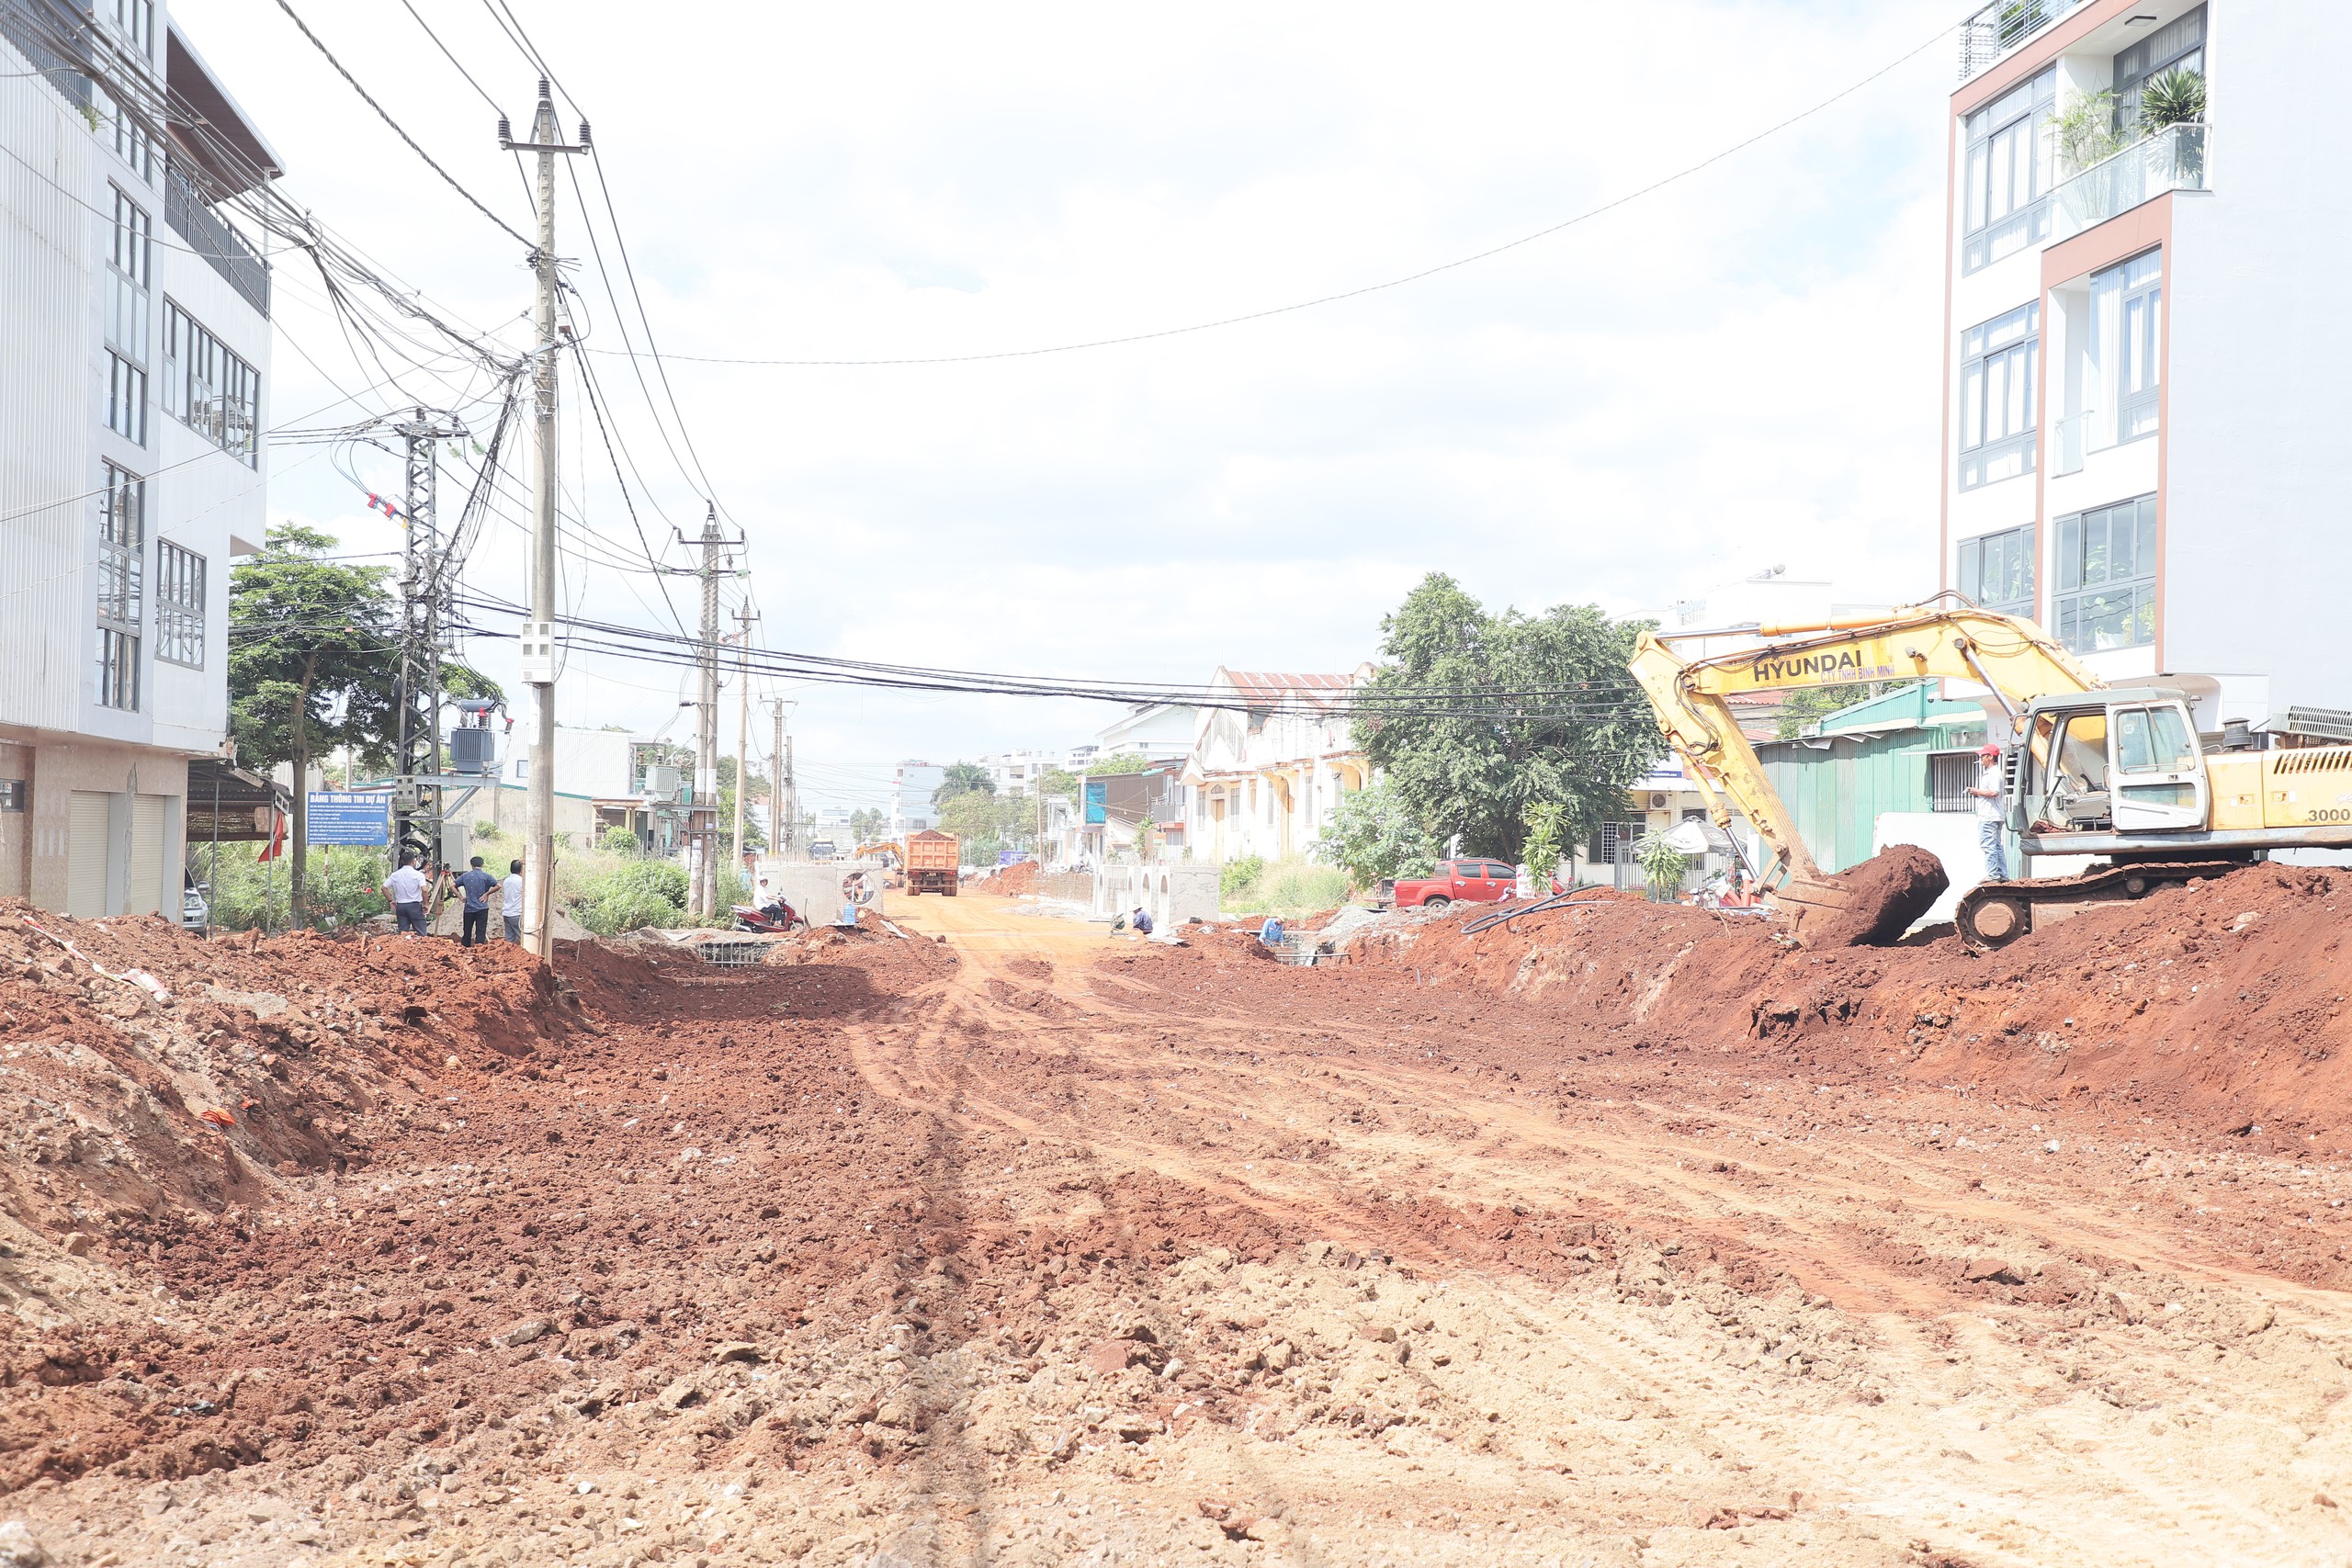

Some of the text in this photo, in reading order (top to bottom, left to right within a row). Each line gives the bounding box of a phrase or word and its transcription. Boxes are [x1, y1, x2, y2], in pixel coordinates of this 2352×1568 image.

[1754, 650, 1861, 682] HYUNDAI
[1838, 668, 1857, 682] TNHH
[1877, 664, 1895, 678] MINH
[310, 792, 386, 806] BẢNG THÔNG TIN DỰ ÁN
[2308, 808, 2351, 822] 3000
